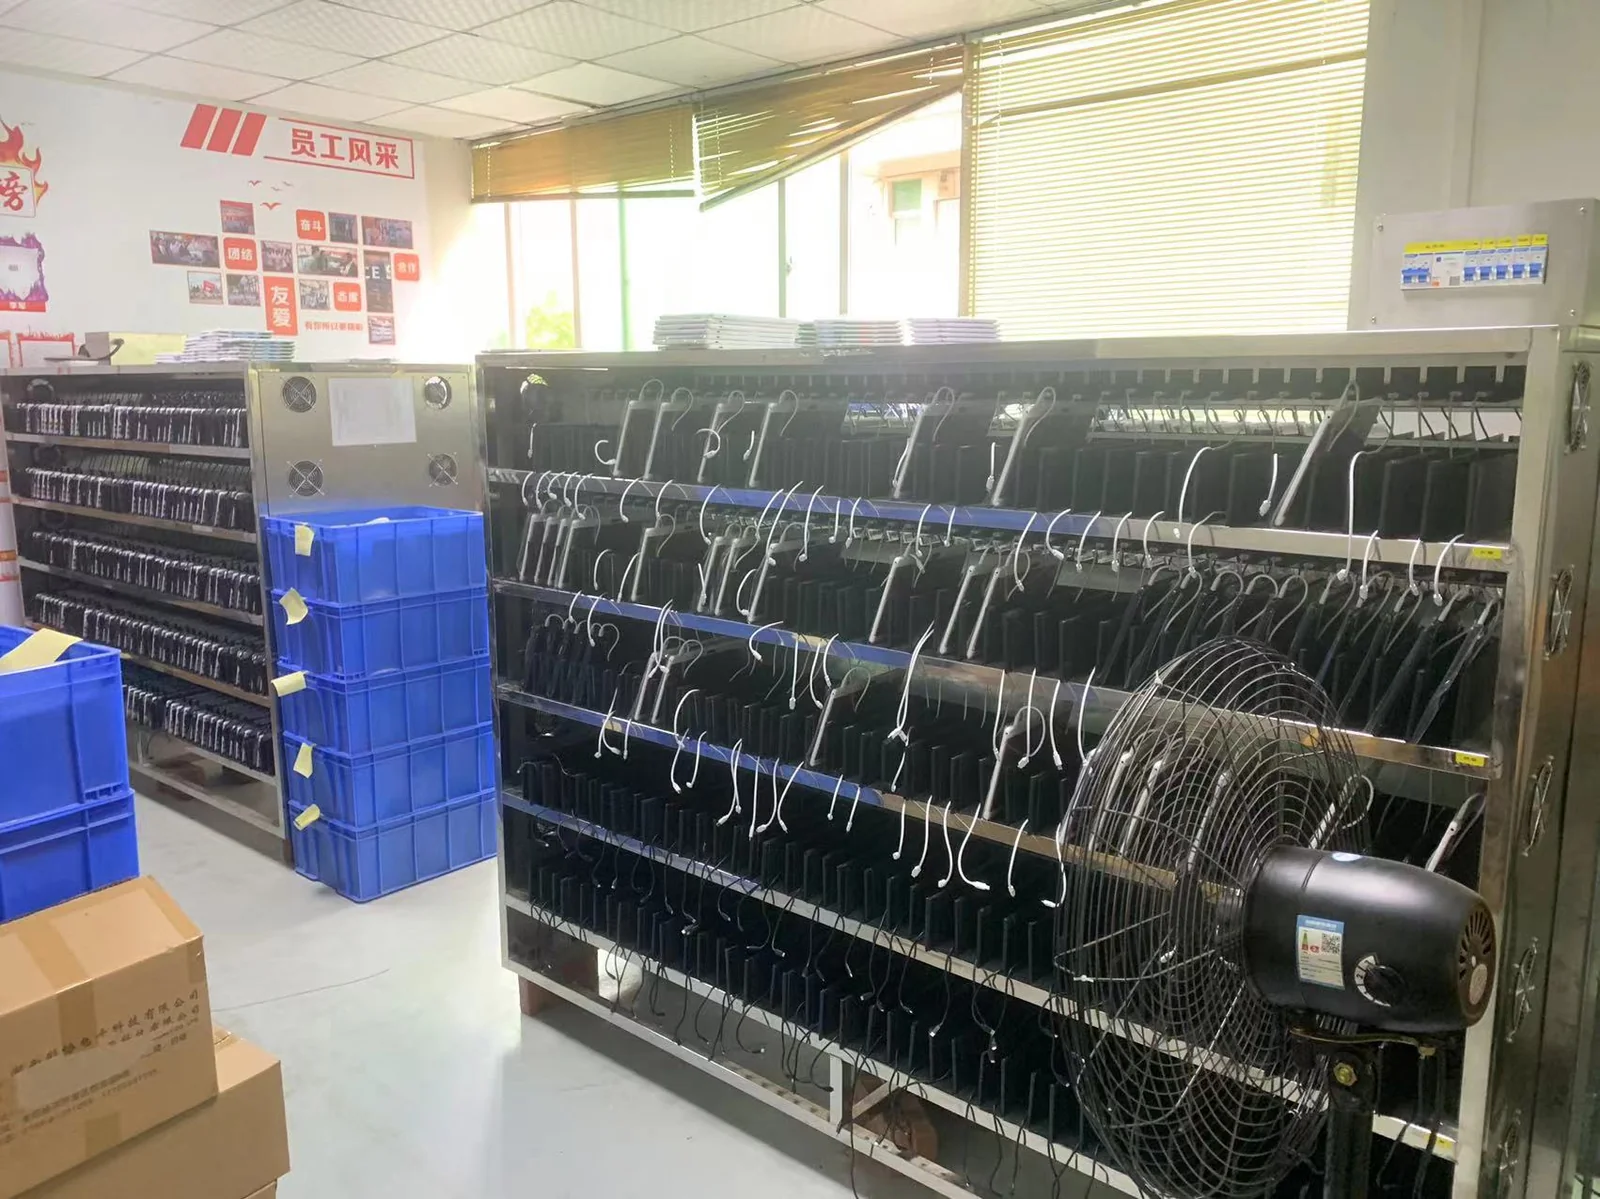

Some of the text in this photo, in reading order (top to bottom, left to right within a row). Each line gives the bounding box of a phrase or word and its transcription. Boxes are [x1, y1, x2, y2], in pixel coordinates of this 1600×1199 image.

[291, 127, 399, 169] 员工风采
[300, 218, 323, 232] 奋斗
[228, 246, 253, 262] 团结
[270, 285, 292, 328] 友爱
